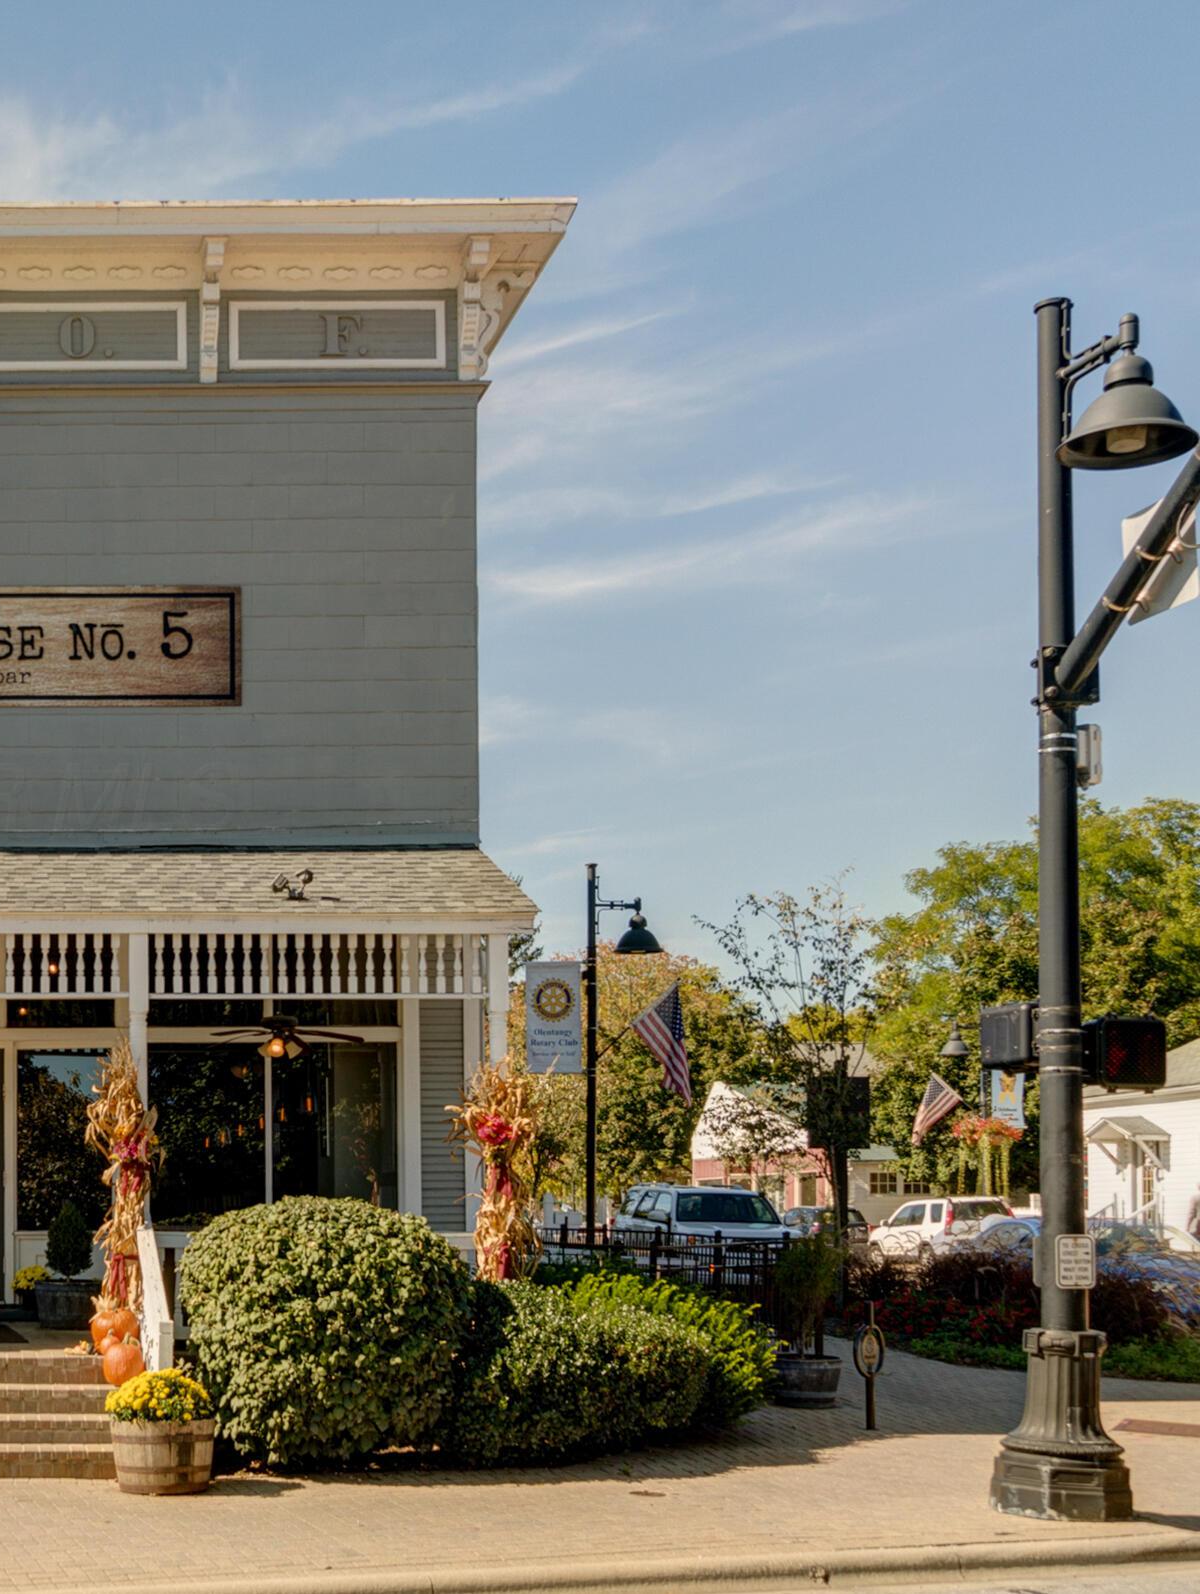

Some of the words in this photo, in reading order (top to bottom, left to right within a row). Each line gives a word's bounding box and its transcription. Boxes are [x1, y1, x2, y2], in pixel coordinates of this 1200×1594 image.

[58, 313, 114, 360] O.
[318, 313, 369, 358] F.
[160, 610, 194, 662] 5
[531, 1039, 555, 1047] Rotary
[534, 1029, 572, 1037] Olentangy
